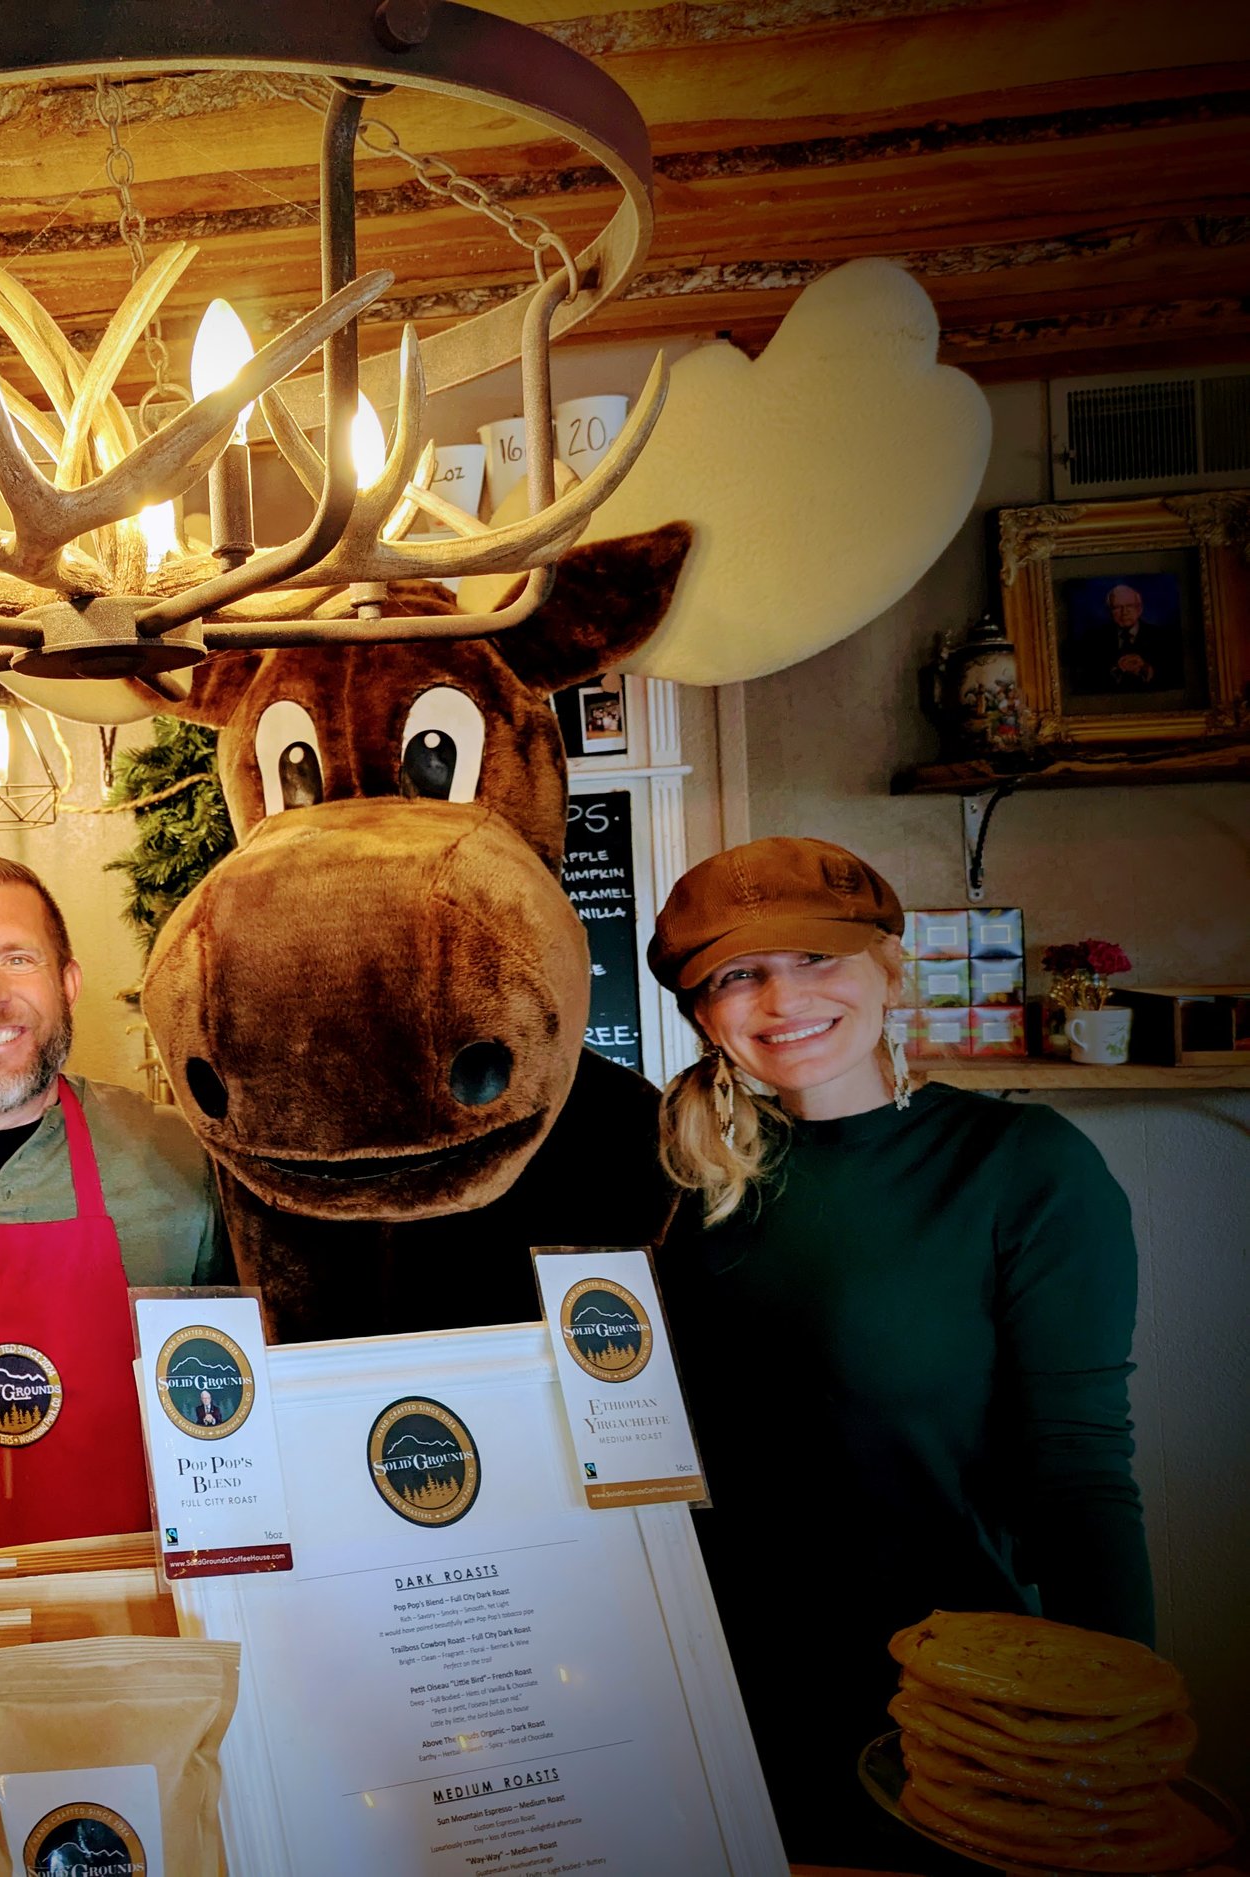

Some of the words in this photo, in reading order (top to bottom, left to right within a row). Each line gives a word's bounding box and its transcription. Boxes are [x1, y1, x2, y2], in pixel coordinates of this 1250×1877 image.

[568, 417, 613, 457] 20
[500, 435, 526, 464] 16
[569, 888, 632, 902] ARAMEL
[578, 907, 626, 919] NILLA
[562, 1323, 594, 1340] SOLID
[595, 1322, 650, 1338] GROUNDS
[18, 1345, 42, 1361] SINCE
[158, 1375, 193, 1391] SOLID
[194, 1374, 252, 1391] GROUNDS
[2, 1384, 61, 1401] GROUNDS
[588, 1397, 658, 1416] ETHIOPIAN
[583, 1415, 670, 1435] YIRGACHEFFE
[599, 1434, 632, 1445] MEDIUM
[635, 1431, 663, 1442] ROAST
[177, 1458, 207, 1476] POP
[372, 1456, 413, 1477] SOLID
[413, 1450, 474, 1471] GROUNDS
[192, 1475, 242, 1494] BLEND
[180, 1498, 204, 1508] FULL
[205, 1496, 226, 1506] CITY
[227, 1495, 258, 1505] ROAST
[264, 1531, 283, 1541] 16oz
[169, 1553, 286, 1568] www.SoidGroundsCoffeeHouse.com
[395, 1573, 433, 1589] DARK
[444, 1564, 497, 1582] ROASTS
[393, 1603, 405, 1612] Pop
[407, 1600, 424, 1610] Pop's
[425, 1597, 444, 1606] Blend
[463, 1593, 475, 1602] City
[476, 1590, 490, 1599] Dark
[491, 1588, 509, 1596] Roast
[390, 1643, 419, 1654] Trailboss
[420, 1639, 446, 1650] Cowboy
[447, 1636, 464, 1645] Roast
[471, 1633, 483, 1641] Full
[484, 1630, 497, 1640] City
[497, 1628, 512, 1636] Dark
[513, 1625, 531, 1634] Roast
[410, 1685, 425, 1693] Petit
[426, 1681, 449, 1691] Oiseau
[492, 1671, 513, 1680] French
[514, 1668, 531, 1676] Roast
[422, 1738, 442, 1748] Above
[443, 1735, 456, 1744] The
[480, 1727, 504, 1738] Organic
[511, 1723, 526, 1732] Dark
[527, 1719, 545, 1729] Roast
[433, 1780, 492, 1802] MEDIUM
[504, 1767, 559, 1788] ROASTS
[437, 1816, 449, 1825] Sun
[451, 1809, 483, 1822] Mountain
[484, 1804, 512, 1817] Espresso
[518, 1797, 546, 1809] Medium
[546, 1794, 565, 1804] Roast
[510, 1844, 538, 1856] Medium
[539, 1840, 557, 1850] Roast
[71, 1863, 145, 1877] GROUNDS
